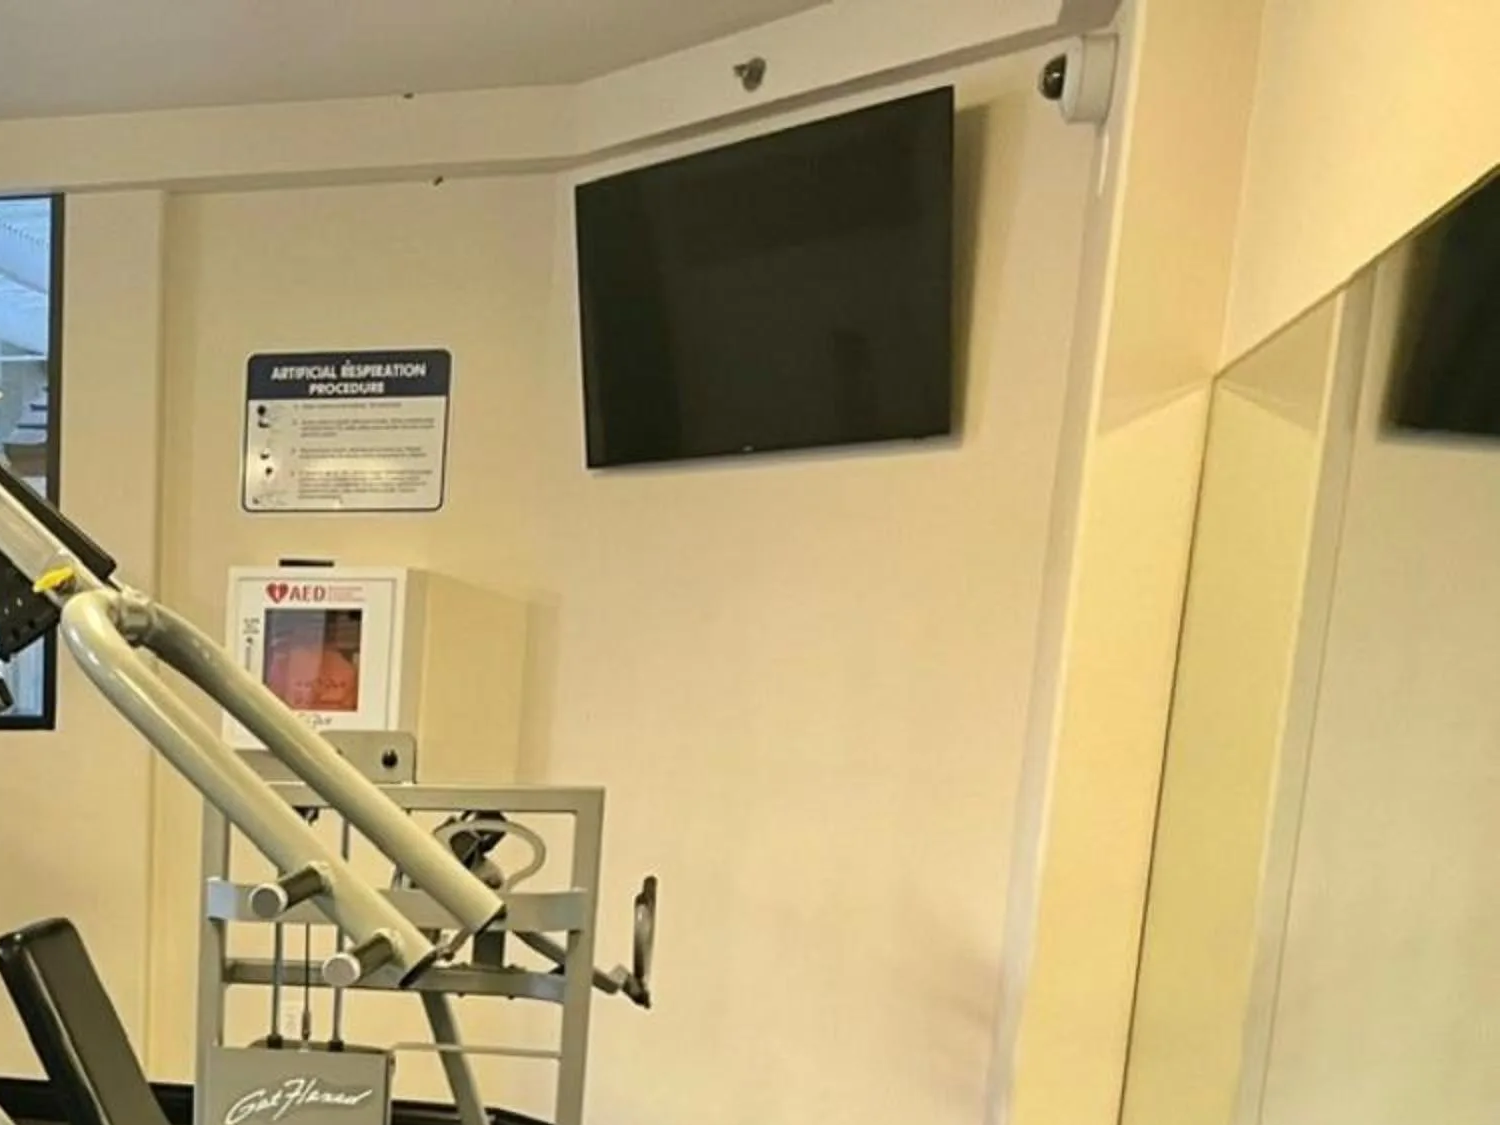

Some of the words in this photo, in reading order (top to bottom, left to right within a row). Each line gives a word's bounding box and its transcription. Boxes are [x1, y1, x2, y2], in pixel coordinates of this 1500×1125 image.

[271, 364, 338, 381] ARTIFICIAL
[308, 381, 386, 396] PROCEDURE
[289, 585, 326, 602] AED
